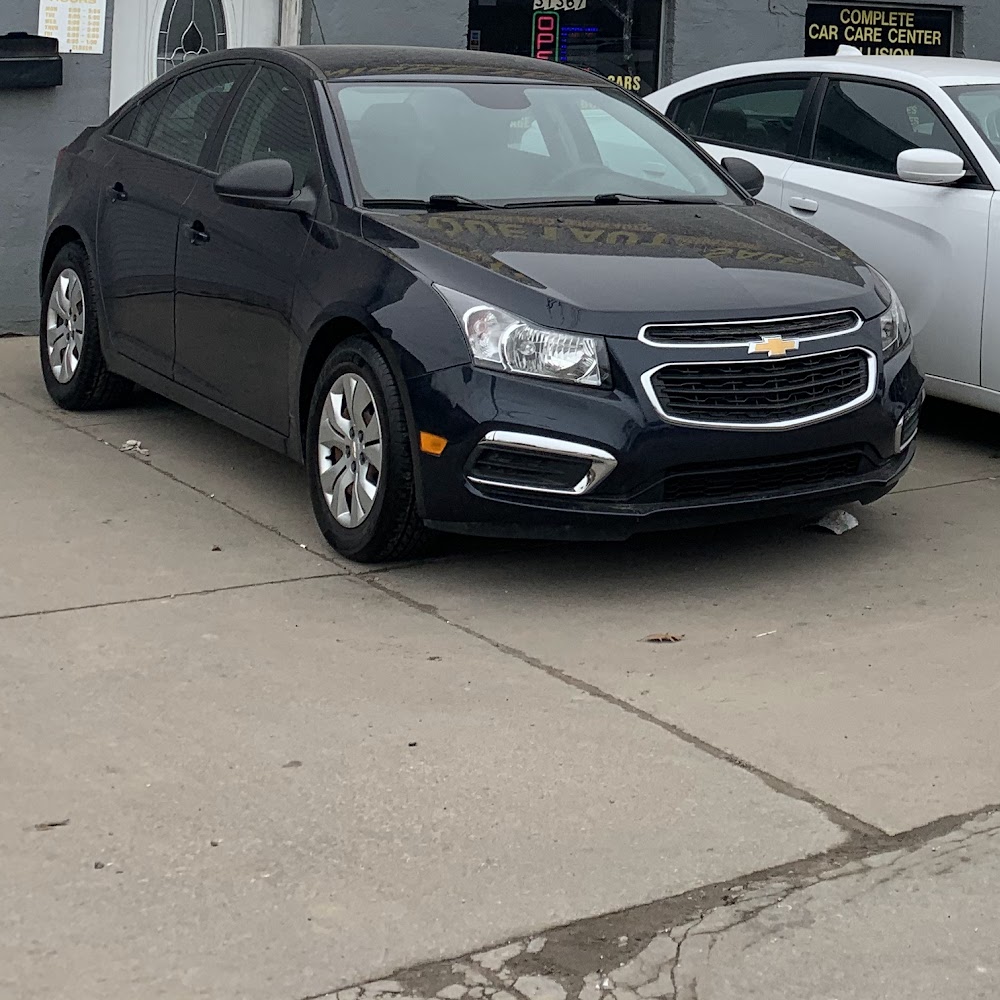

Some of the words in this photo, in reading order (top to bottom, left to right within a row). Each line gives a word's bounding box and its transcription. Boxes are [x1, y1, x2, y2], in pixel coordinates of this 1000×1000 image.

[839, 8, 915, 28] COMPLETE
[536, 16, 555, 60] OPE
[808, 23, 839, 41] CAR
[844, 26, 883, 43] CARE
[887, 28, 942, 46] CENTER
